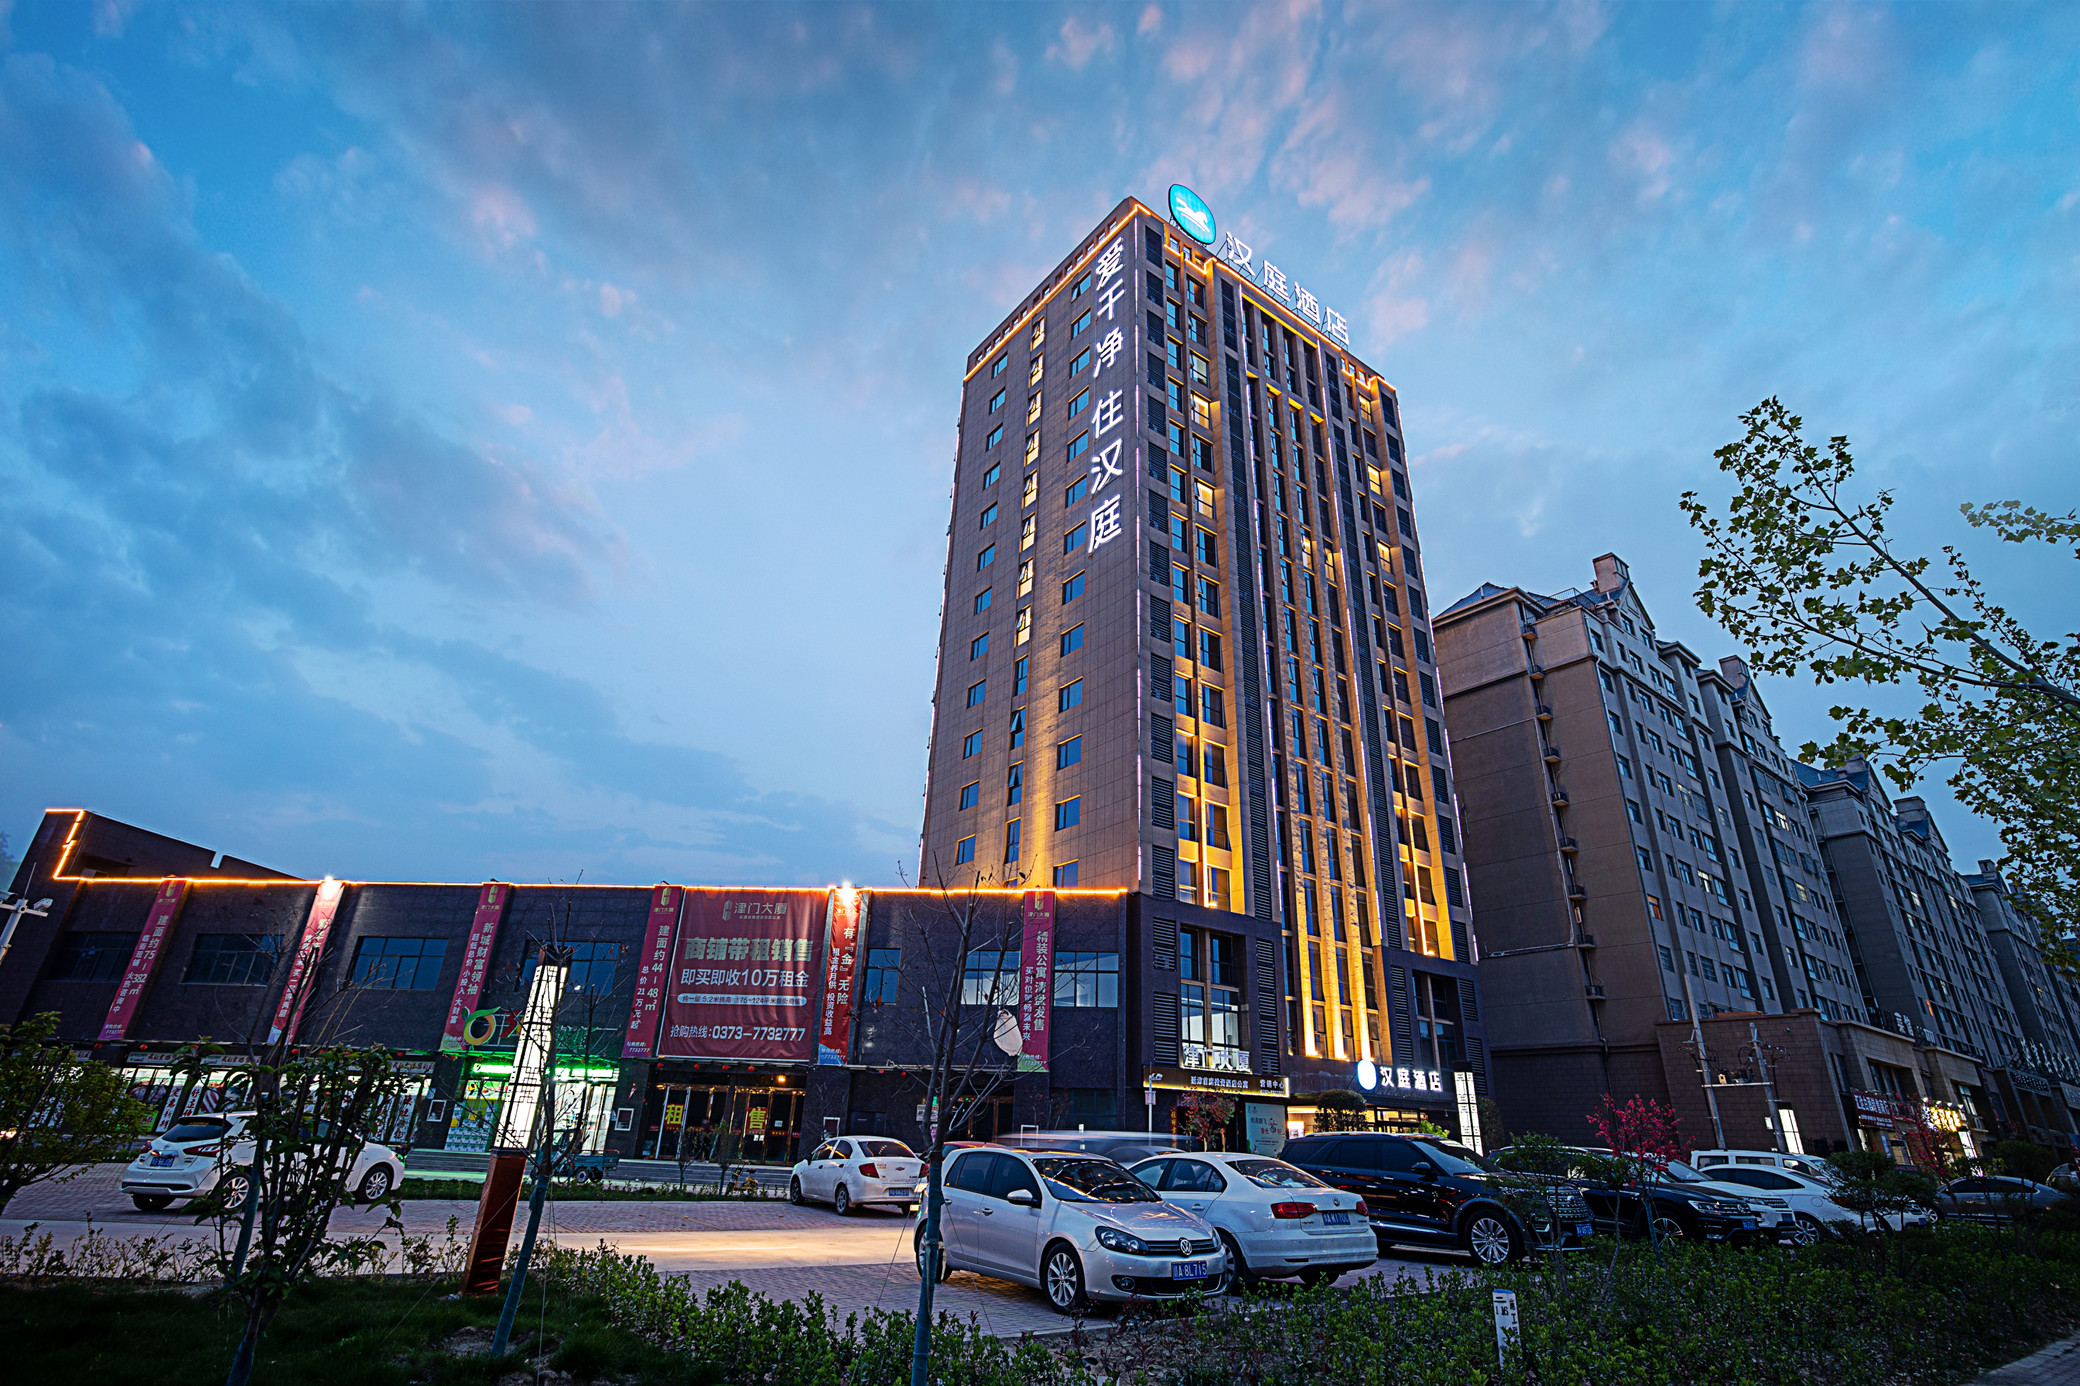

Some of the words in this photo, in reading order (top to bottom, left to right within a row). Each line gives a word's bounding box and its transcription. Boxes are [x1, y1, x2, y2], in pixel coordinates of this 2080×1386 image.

[1225, 231, 1350, 346] 汉庭酒店
[733, 902, 788, 916] 津门大厦
[465, 933, 480, 967] 超低总价
[466, 922, 495, 996] 新城财富领袖
[684, 937, 814, 962] 商铺带租销售
[1034, 930, 1048, 978] 精装公寓
[680, 968, 810, 988] 即买即收10万租金
[828, 948, 842, 989] 租金养月供
[457, 970, 471, 995] 小投入
[449, 998, 463, 1024] 大财富
[630, 965, 650, 1030] 总价21万元起
[1033, 981, 1047, 1031] 清盘发售
[823, 992, 836, 1036] 投资收益高
[1183, 1045, 1251, 1073] 津门大厦
[1259, 1079, 1285, 1089] 营销中心
[1380, 1066, 1444, 1092] 汉庭酒店
[664, 1103, 684, 1126] 租
[748, 1107, 767, 1130] 售
